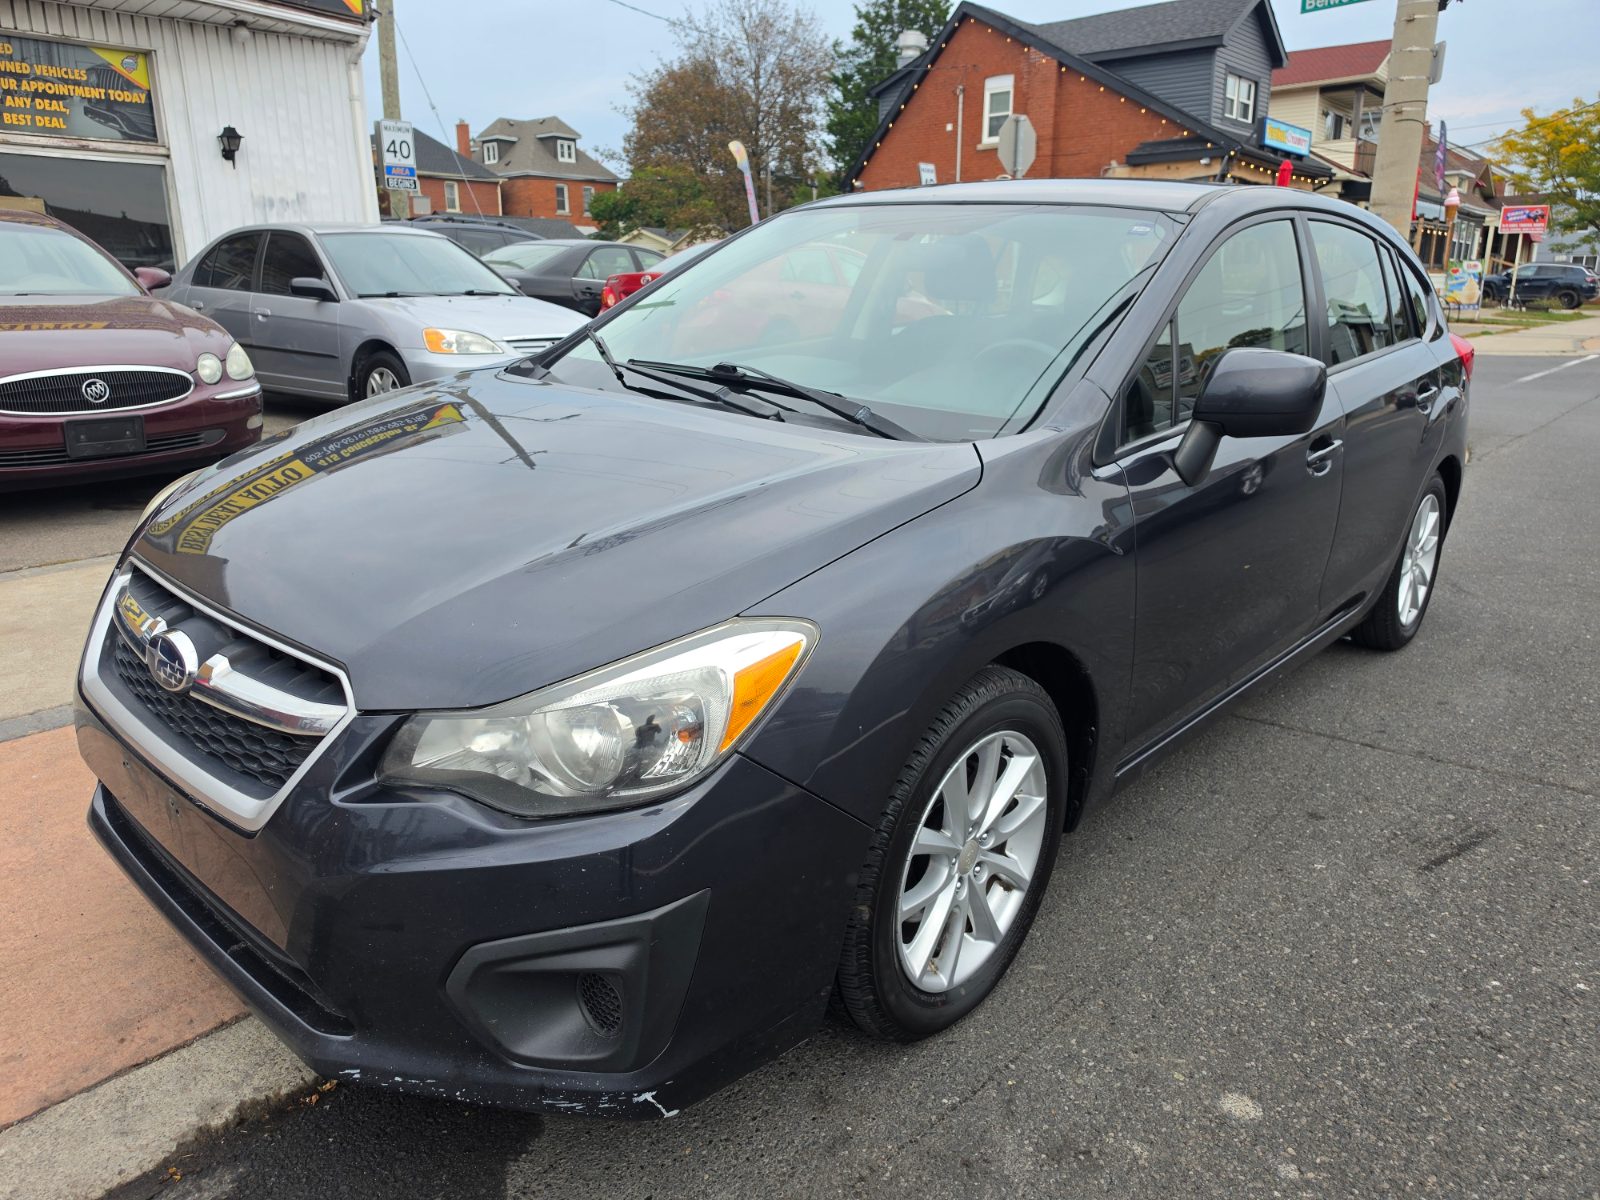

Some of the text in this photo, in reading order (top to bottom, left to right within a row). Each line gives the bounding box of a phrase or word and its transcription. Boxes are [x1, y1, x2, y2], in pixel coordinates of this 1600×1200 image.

[34, 64, 87, 81] VEHICLES
[21, 79, 105, 100] APPOINTMENT
[107, 89, 146, 104] TODAY
[5, 96, 70, 115] ANY DEAL,
[3, 112, 67, 129] BEST DEAL
[386, 139, 411, 159] 40
